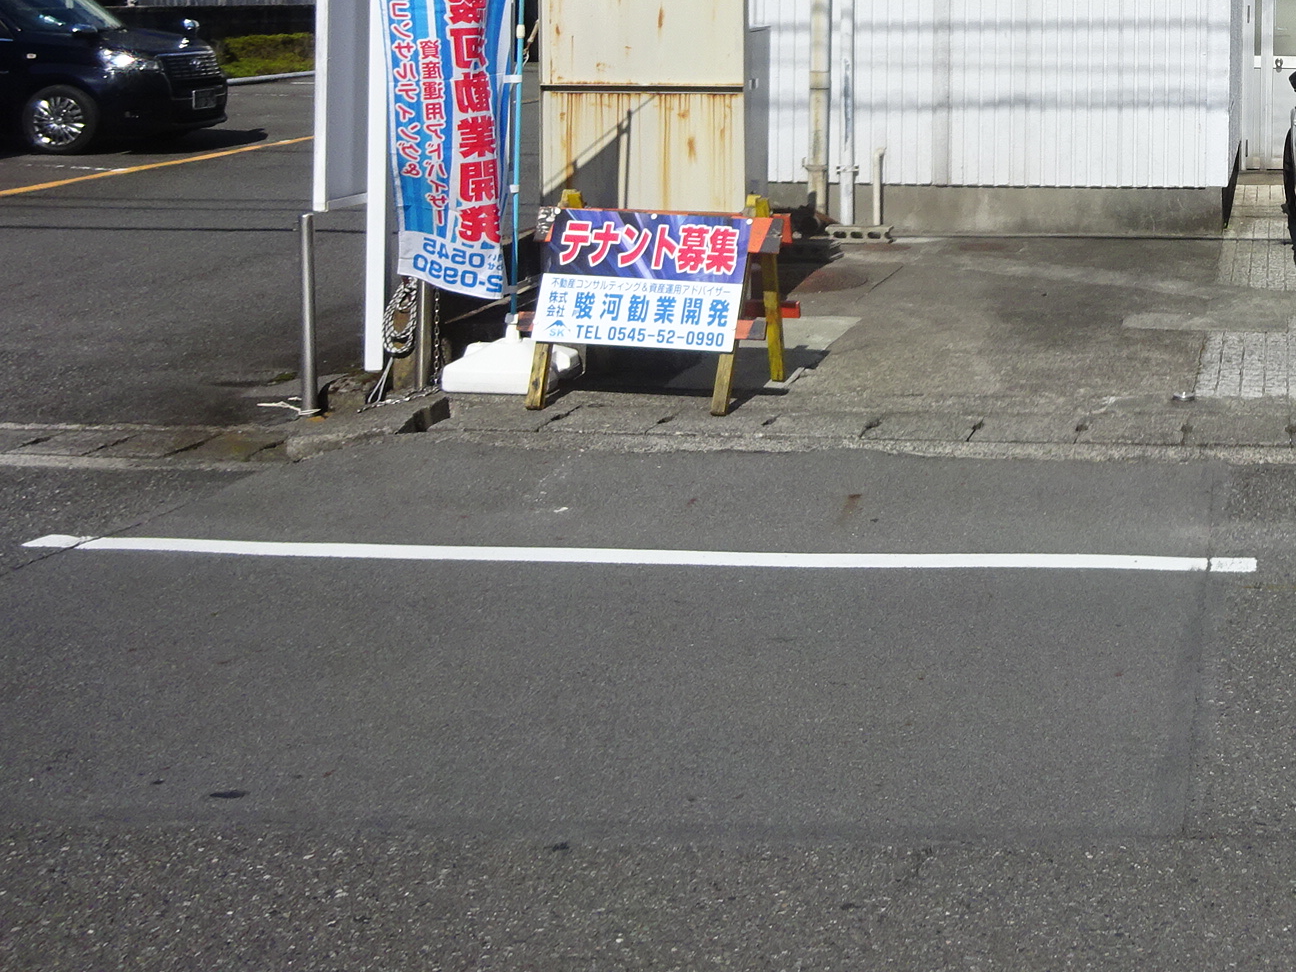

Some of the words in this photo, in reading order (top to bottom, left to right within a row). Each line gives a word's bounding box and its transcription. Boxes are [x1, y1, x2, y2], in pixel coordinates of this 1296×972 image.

[560, 220, 739, 275] テナント募集
[549, 291, 567, 304] 株式
[546, 304, 565, 318] 会社
[573, 291, 730, 328] 駿河勧業開発
[549, 329, 565, 338] SK
[576, 324, 602, 340] TEL
[607, 326, 725, 347] 0545-52-0990
